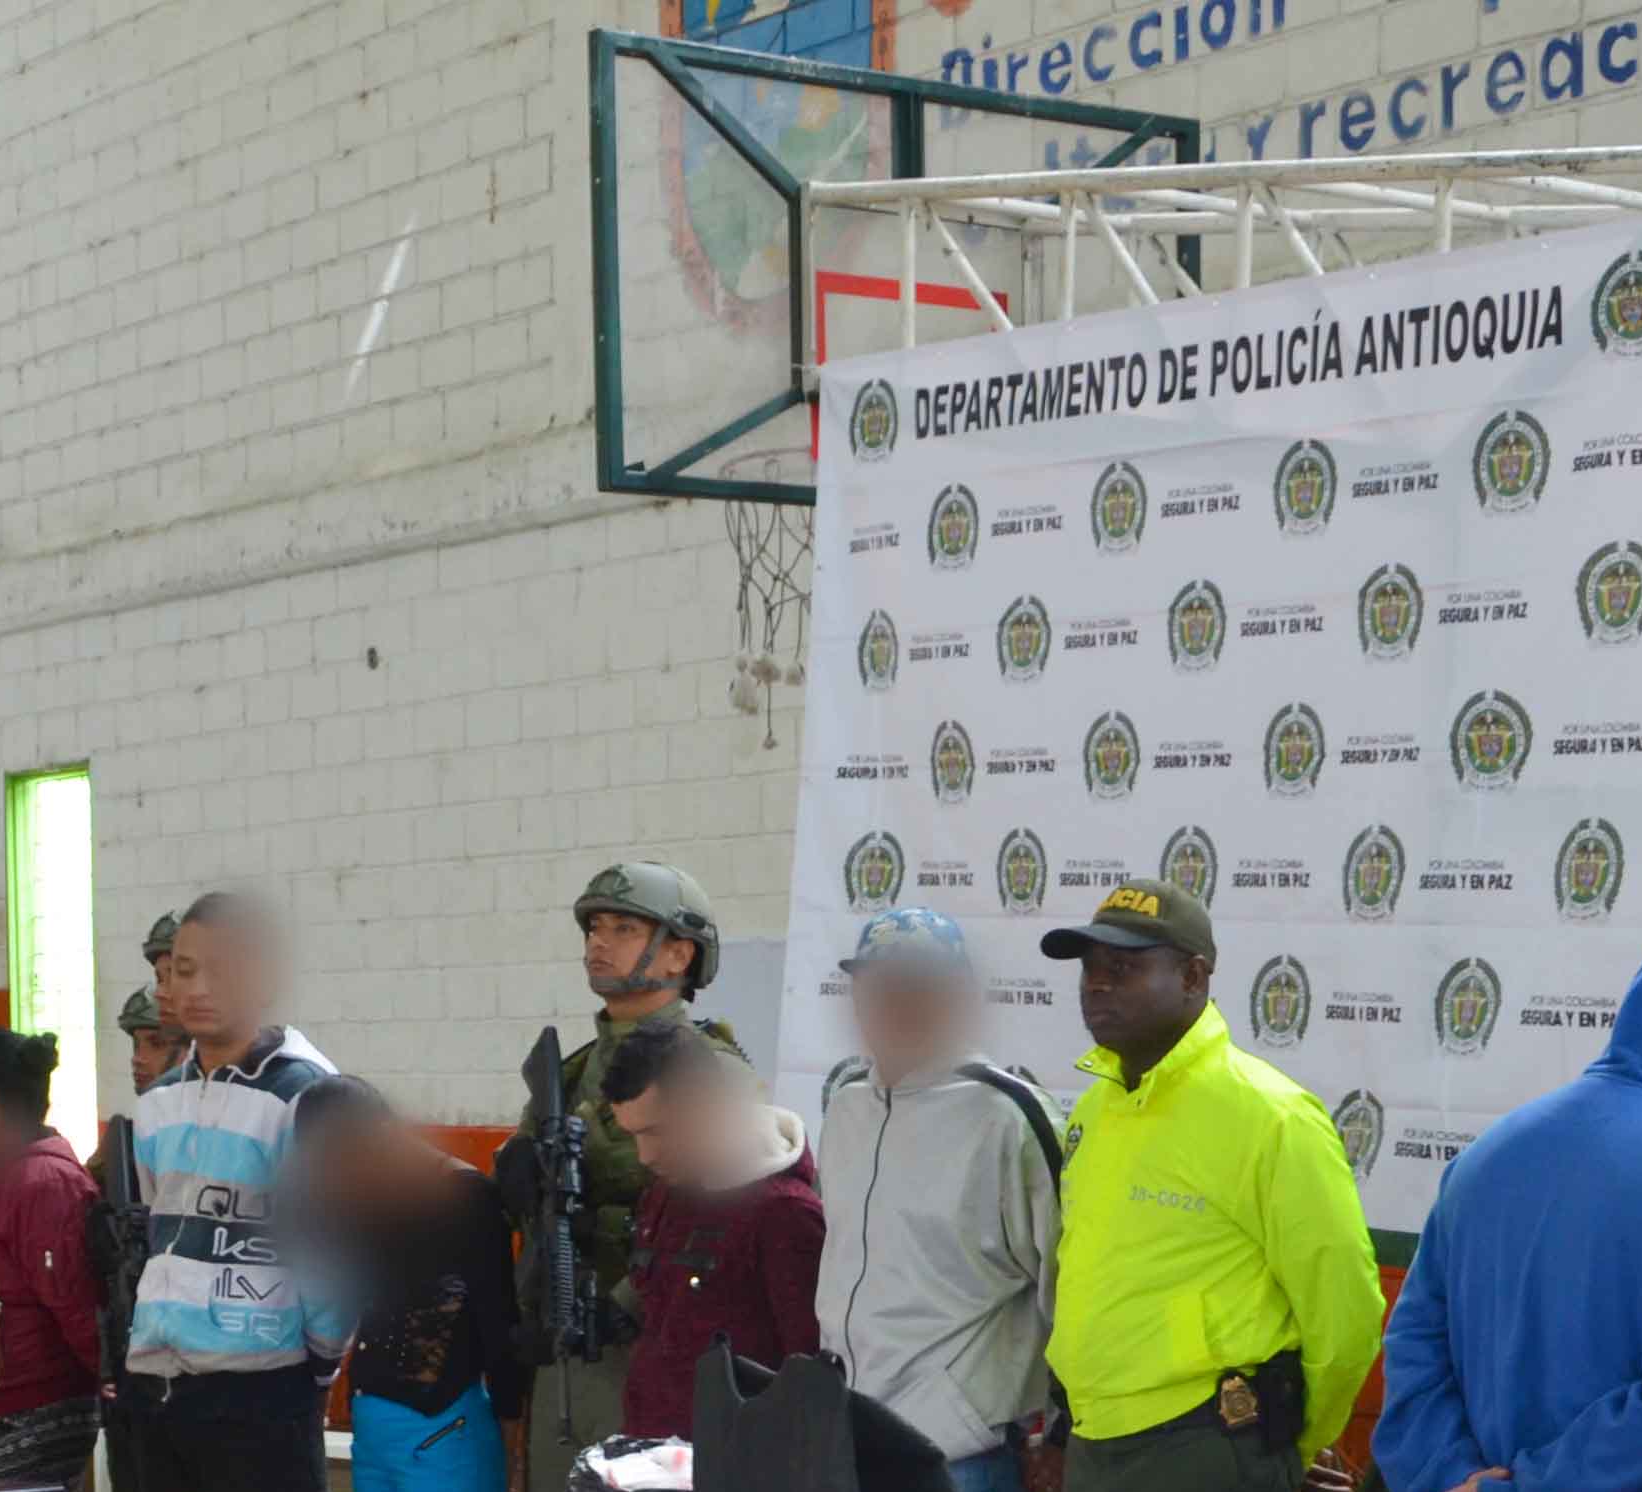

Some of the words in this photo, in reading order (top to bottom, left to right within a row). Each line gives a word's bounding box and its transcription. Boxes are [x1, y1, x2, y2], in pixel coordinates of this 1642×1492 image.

[915, 352, 1148, 439] DEPARTAMENTO
[1158, 343, 1199, 404] DE
[1209, 308, 1343, 397] POLICÍA
[1354, 285, 1563, 377] ANTIOQUIA
[1572, 453, 1612, 473] SEGURA
[1616, 451, 1626, 469] Y
